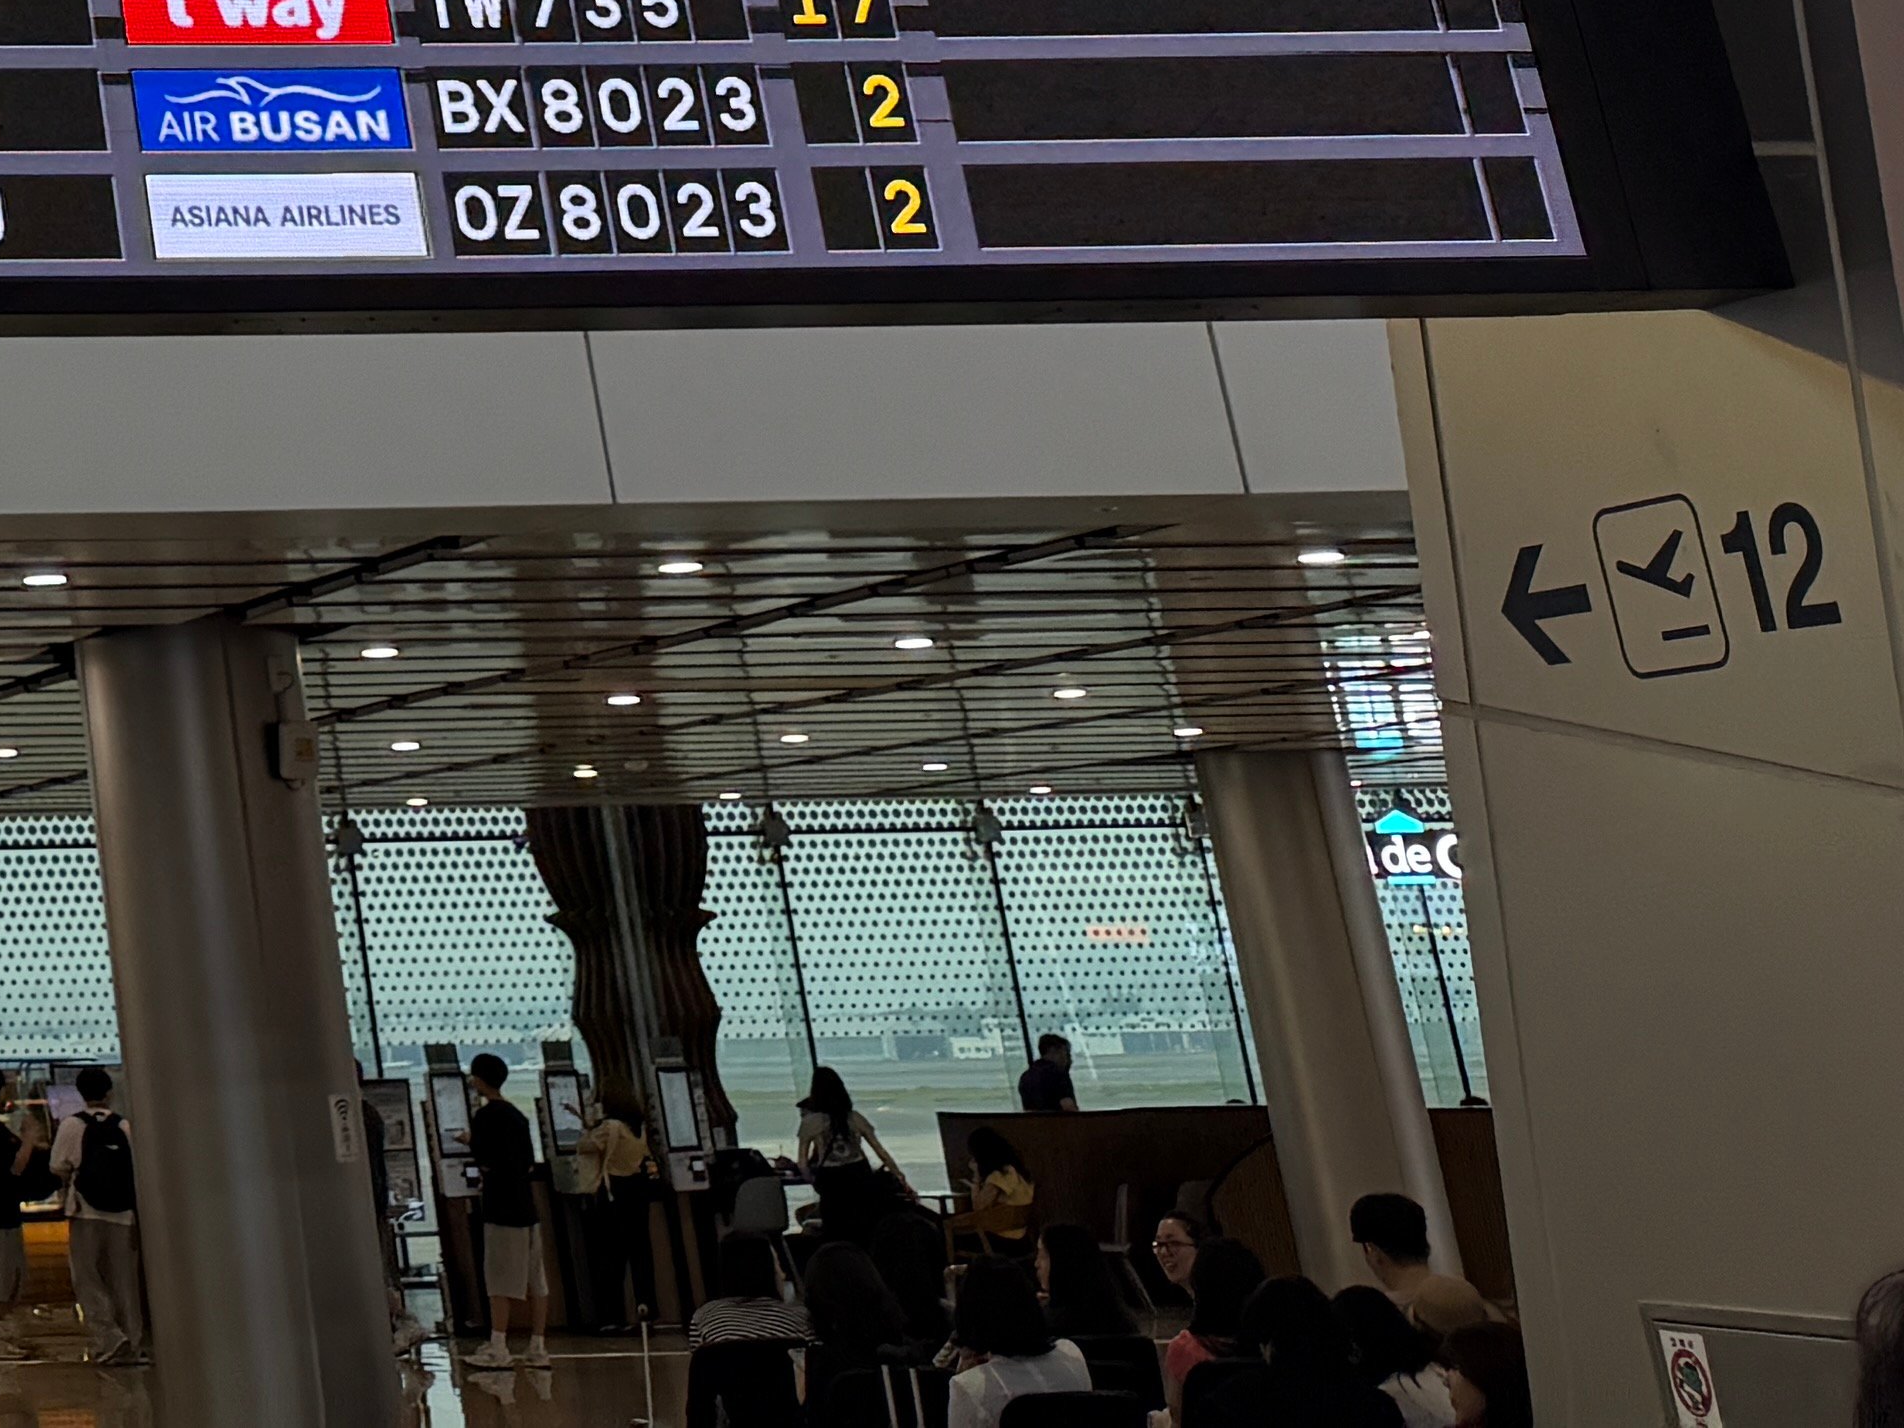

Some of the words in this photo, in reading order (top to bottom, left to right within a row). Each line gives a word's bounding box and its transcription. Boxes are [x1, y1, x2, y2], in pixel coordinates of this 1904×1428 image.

[159, 112, 222, 142] AIR
[231, 106, 390, 141] BUSAN
[436, 76, 756, 134] BX8023
[863, 74, 905, 128] 2
[169, 203, 270, 229] ASIANA
[281, 201, 401, 229] AIRLINES
[454, 181, 776, 241] OZ8023
[884, 179, 927, 234] 2
[1720, 500, 1843, 634] 12
[1381, 834, 1433, 874] de
